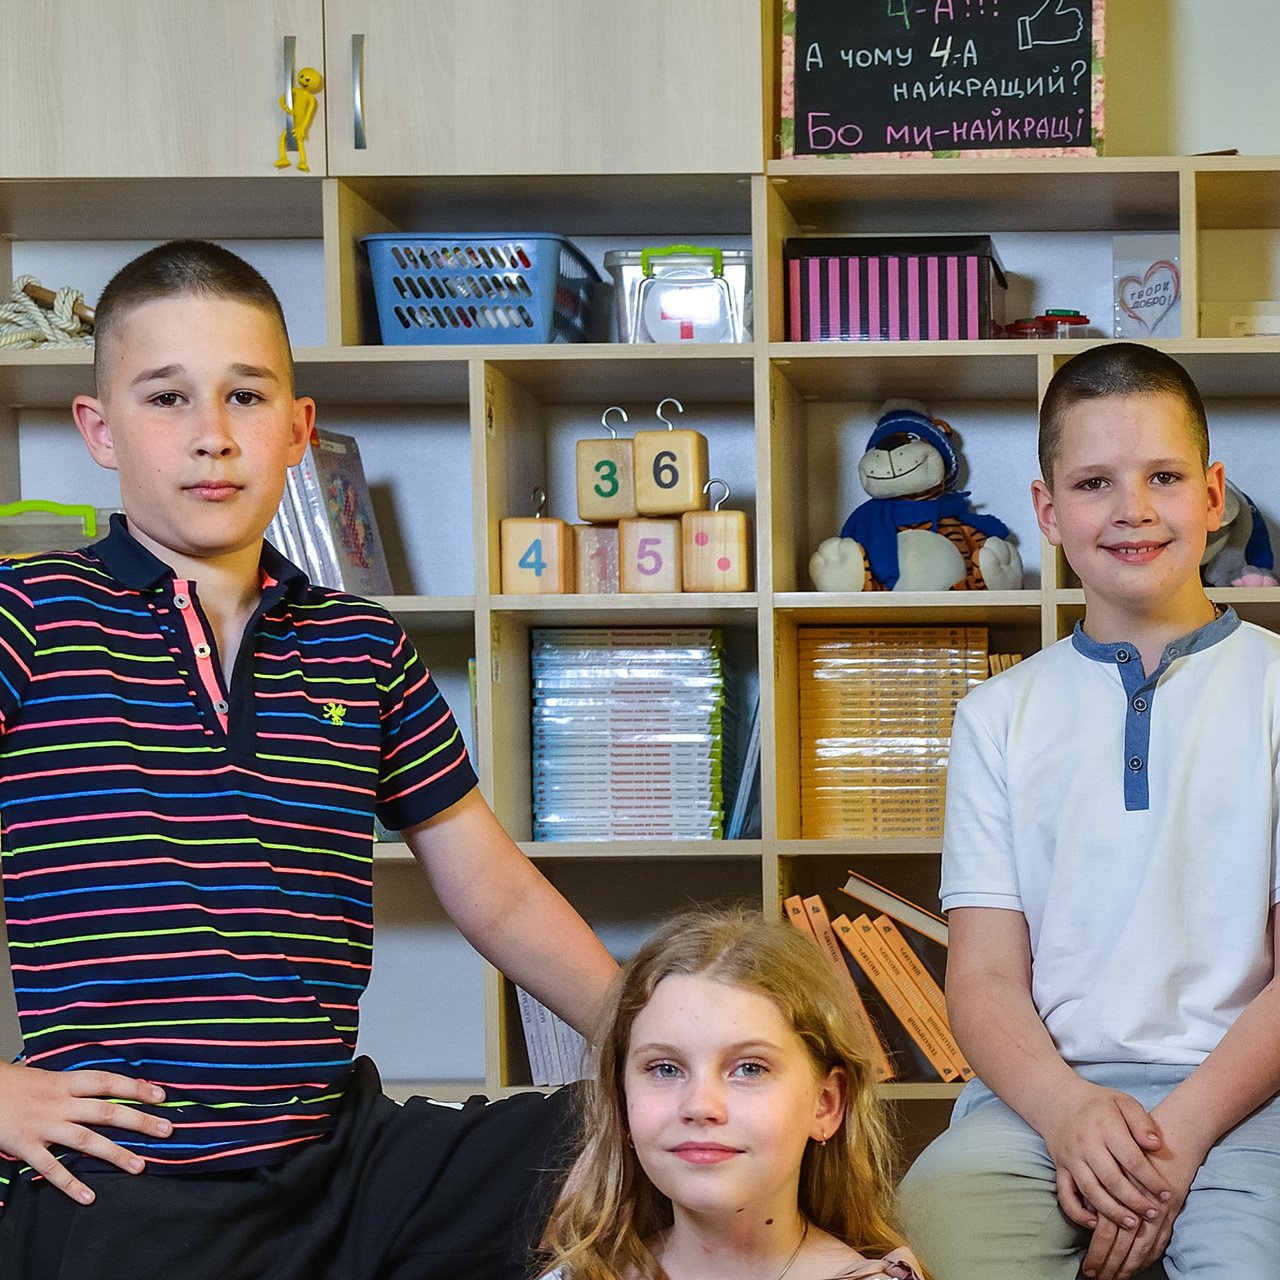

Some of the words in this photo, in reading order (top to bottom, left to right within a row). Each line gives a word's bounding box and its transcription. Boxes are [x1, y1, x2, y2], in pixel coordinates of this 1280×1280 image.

[805, 42, 824, 72] А
[1130, 281, 1170, 301] ТВОРИ
[1131, 294, 1173, 310] ДОБРО!
[594, 460, 620, 498] 3
[652, 451, 680, 489] 6
[518, 538, 548, 578] 4
[589, 545, 609, 582] 1
[636, 538, 664, 576] 5
